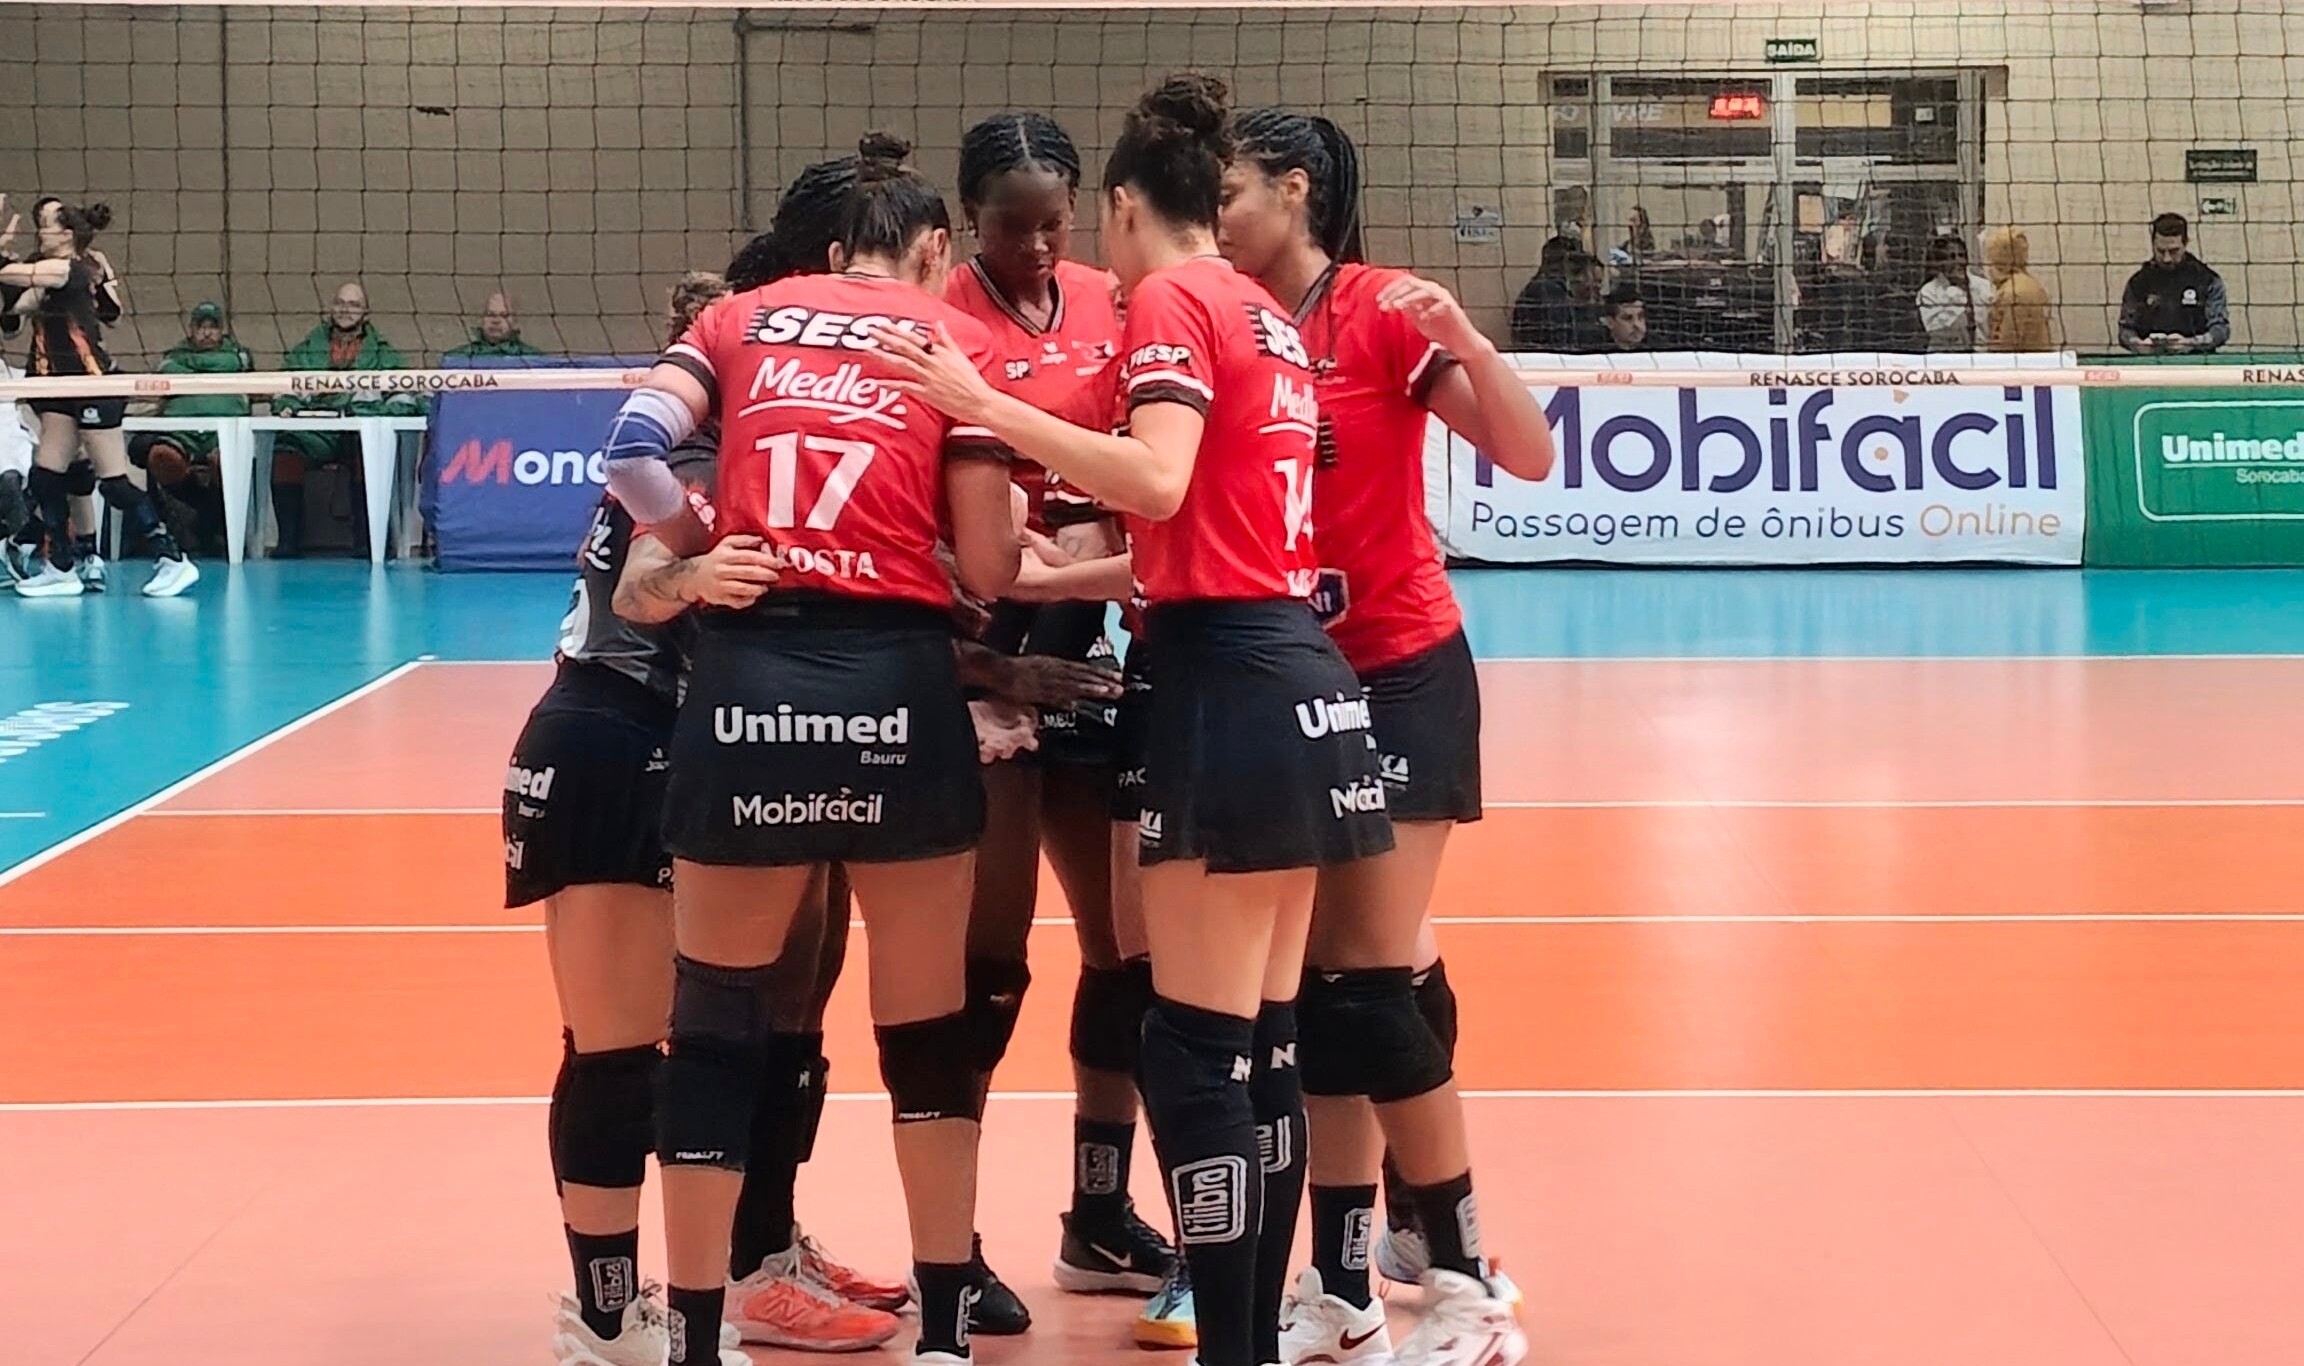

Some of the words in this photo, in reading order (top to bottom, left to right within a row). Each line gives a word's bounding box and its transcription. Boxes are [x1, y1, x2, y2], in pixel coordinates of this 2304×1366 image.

[1767, 41, 1815, 57] SAÍDA
[291, 375, 381, 390] RENASCE
[388, 374, 499, 389] SOROCABA
[1750, 371, 1840, 386] RENASCE
[1847, 371, 1961, 386] SOROCABA
[2161, 432, 2304, 462] Unimed
[754, 432, 876, 531] 17
[1472, 501, 1679, 546] Passagem
[1696, 506, 1746, 538] de
[1761, 506, 1905, 538] ônibus
[1920, 503, 2061, 537] Online
[714, 704, 909, 744] Unimed
[860, 750, 907, 765] Bauru
[732, 786, 884, 826] Mobifácil
[1181, 1167, 1229, 1234] tilibra
